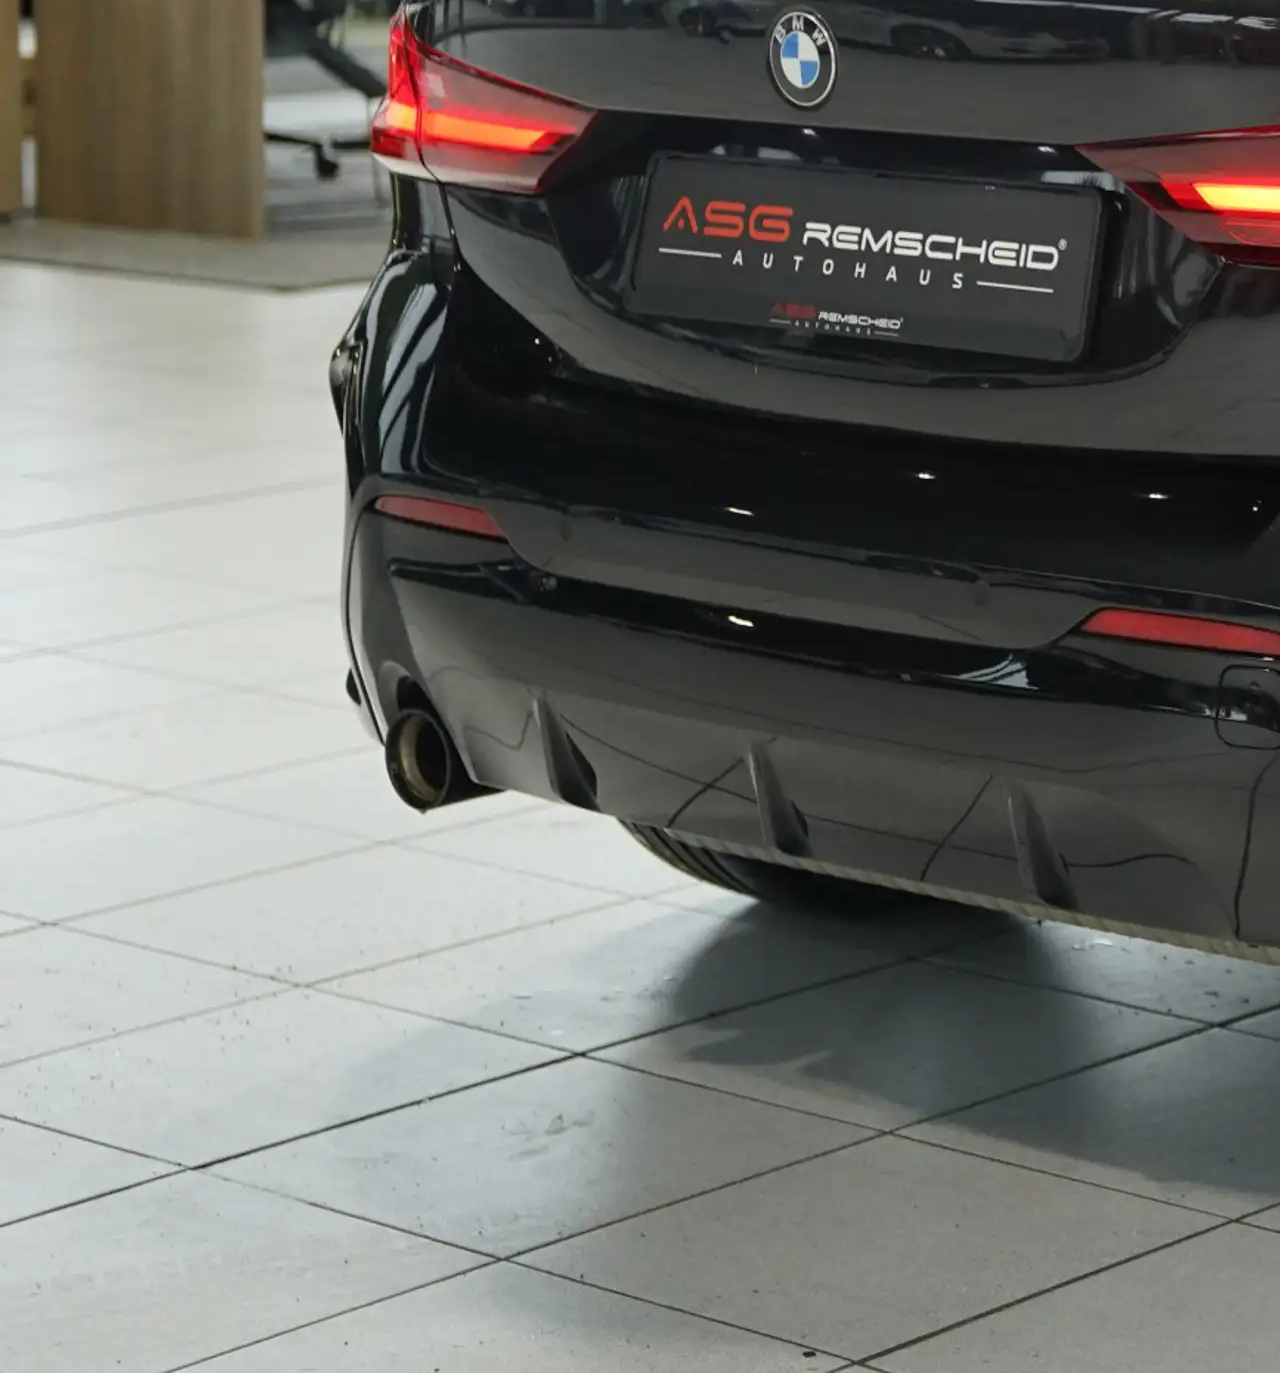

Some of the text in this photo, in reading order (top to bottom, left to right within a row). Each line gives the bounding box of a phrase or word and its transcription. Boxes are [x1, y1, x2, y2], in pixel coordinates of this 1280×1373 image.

[774, 15, 827, 46] BMW
[663, 196, 1059, 271] ASG REMSCHEID
[732, 249, 963, 289] AUTOHAUS
